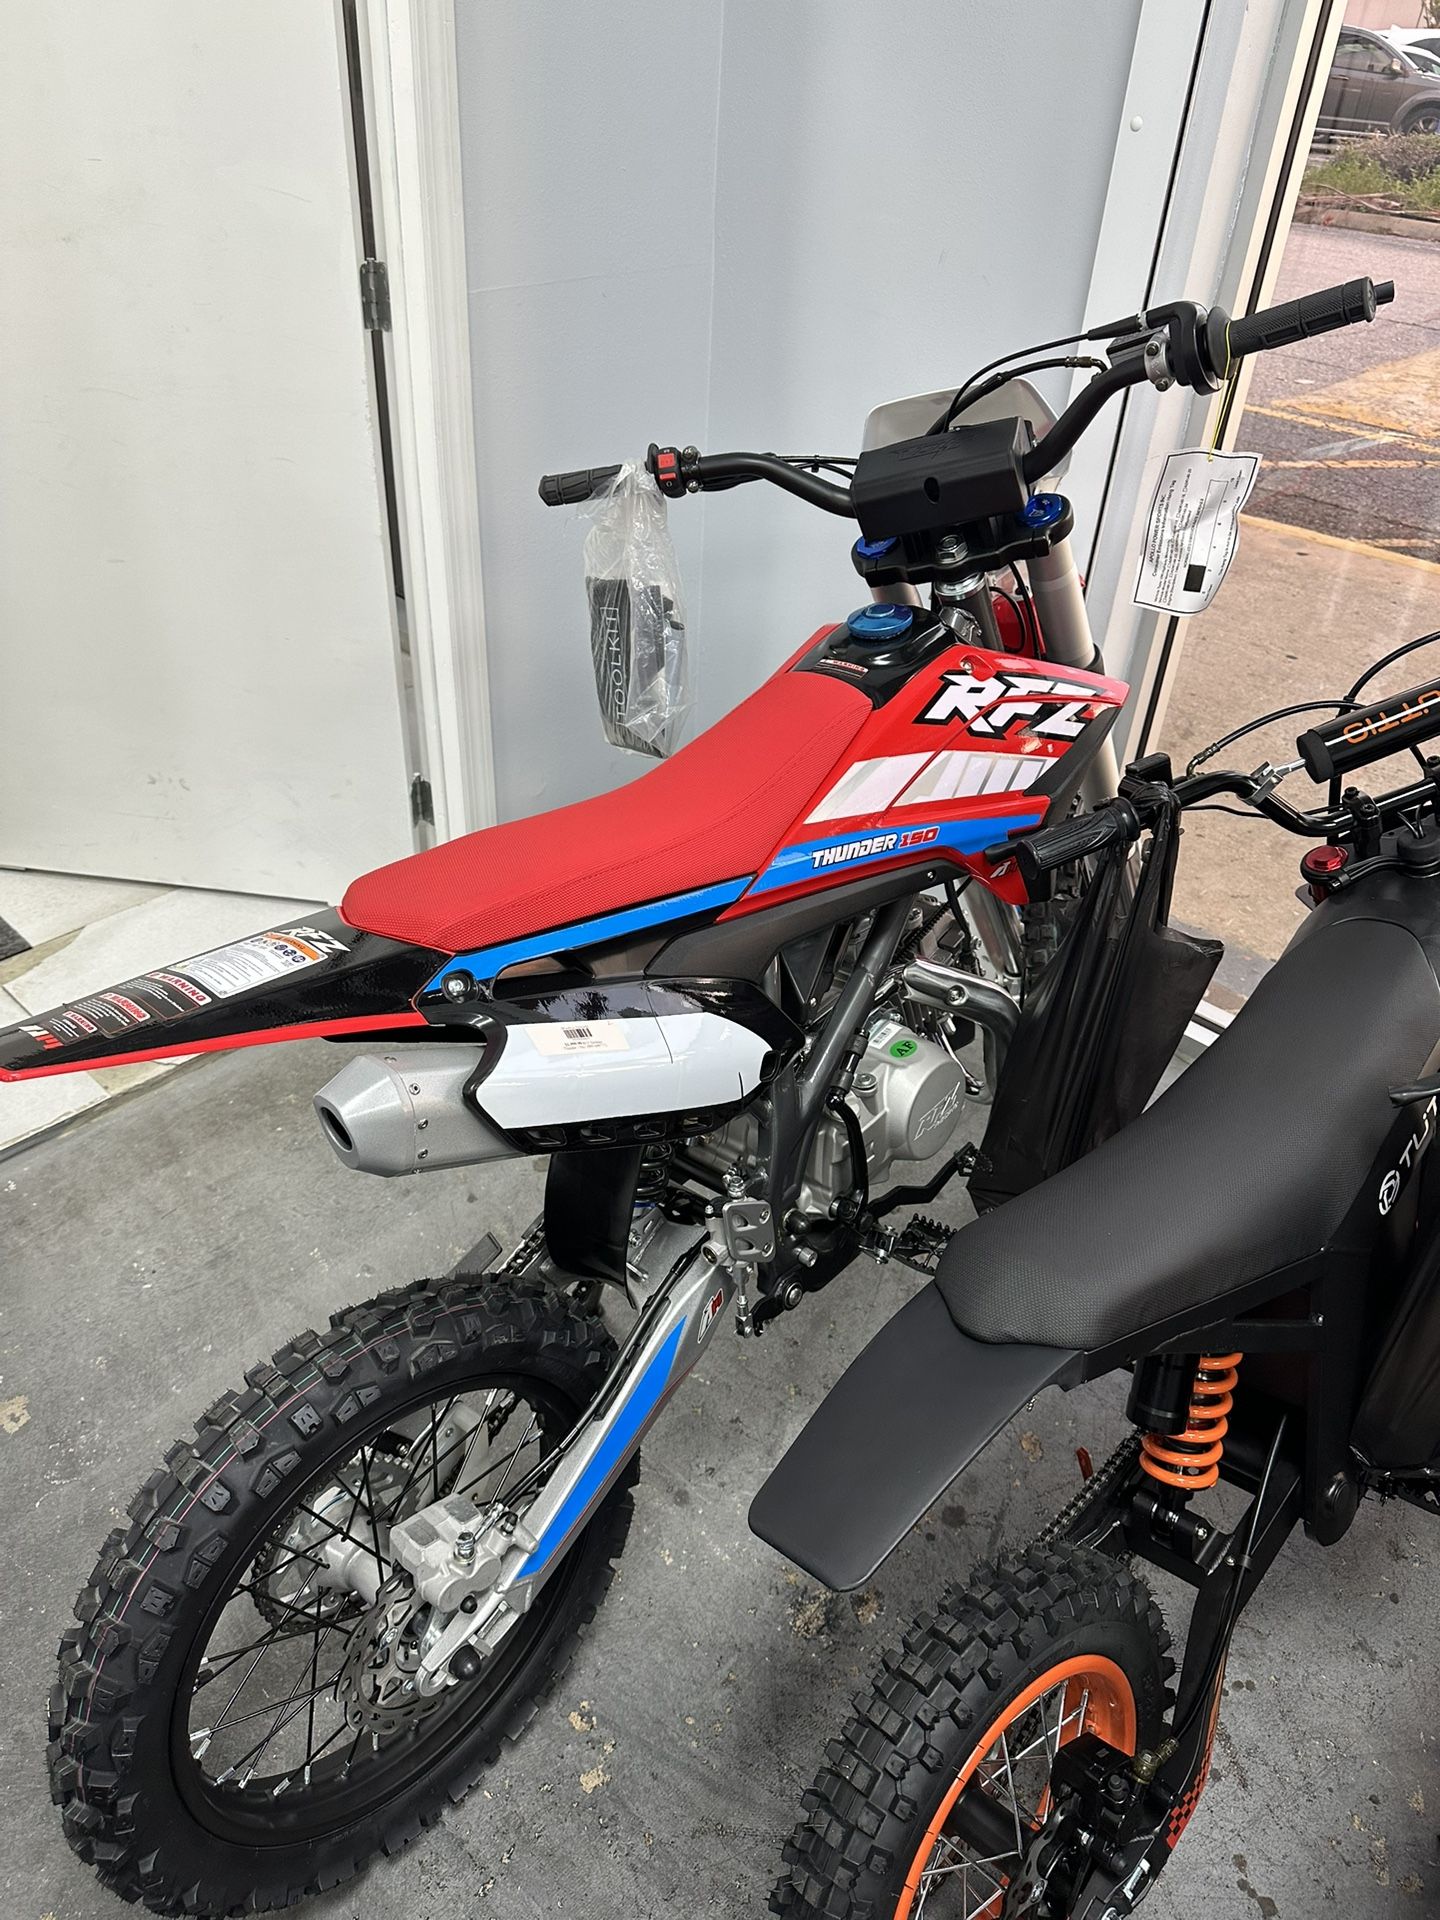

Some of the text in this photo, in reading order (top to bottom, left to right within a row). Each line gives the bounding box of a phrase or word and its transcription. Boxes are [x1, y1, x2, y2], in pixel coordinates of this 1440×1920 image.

[606, 616, 626, 720] TOOLKIT
[920, 671, 1097, 740] RFZ
[811, 825, 940, 869] THUNDER 150
[280, 926, 351, 953] RFZ
[159, 974, 206, 1002] WARNING
[896, 1041, 914, 1057] AF
